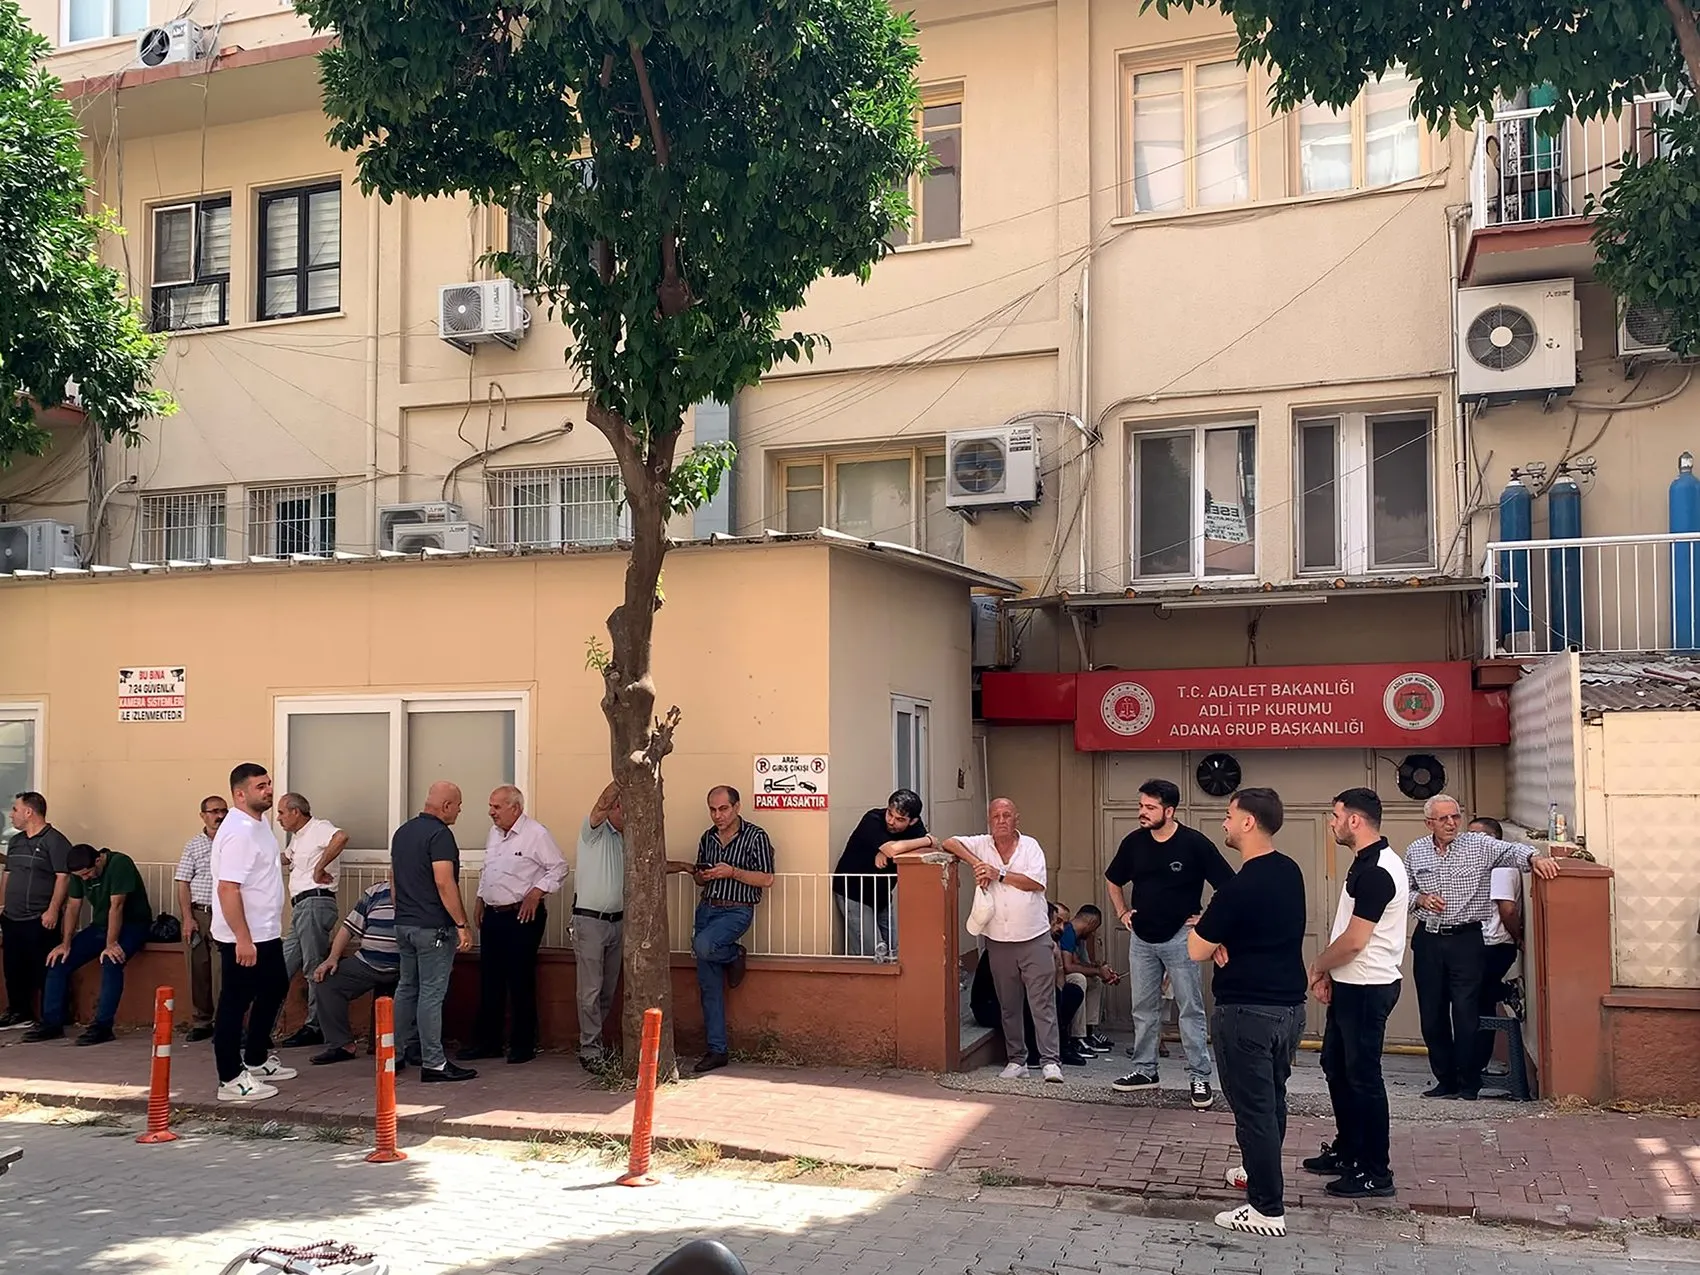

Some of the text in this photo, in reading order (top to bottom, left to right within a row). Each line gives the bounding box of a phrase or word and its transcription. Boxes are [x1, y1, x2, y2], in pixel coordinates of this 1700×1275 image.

[139, 670, 148, 680] BU
[1177, 679, 1354, 698] T.C. ADALET BAKANLIĞI
[119, 697, 146, 707] KAMERA
[1199, 701, 1332, 717] ADLİ TIP KURUMU
[1169, 718, 1364, 737] ADANA GRUP BAŞKANLIĞI
[782, 756, 799, 764] ARAÇ
[756, 796, 825, 807] PARK YASAKTIR
